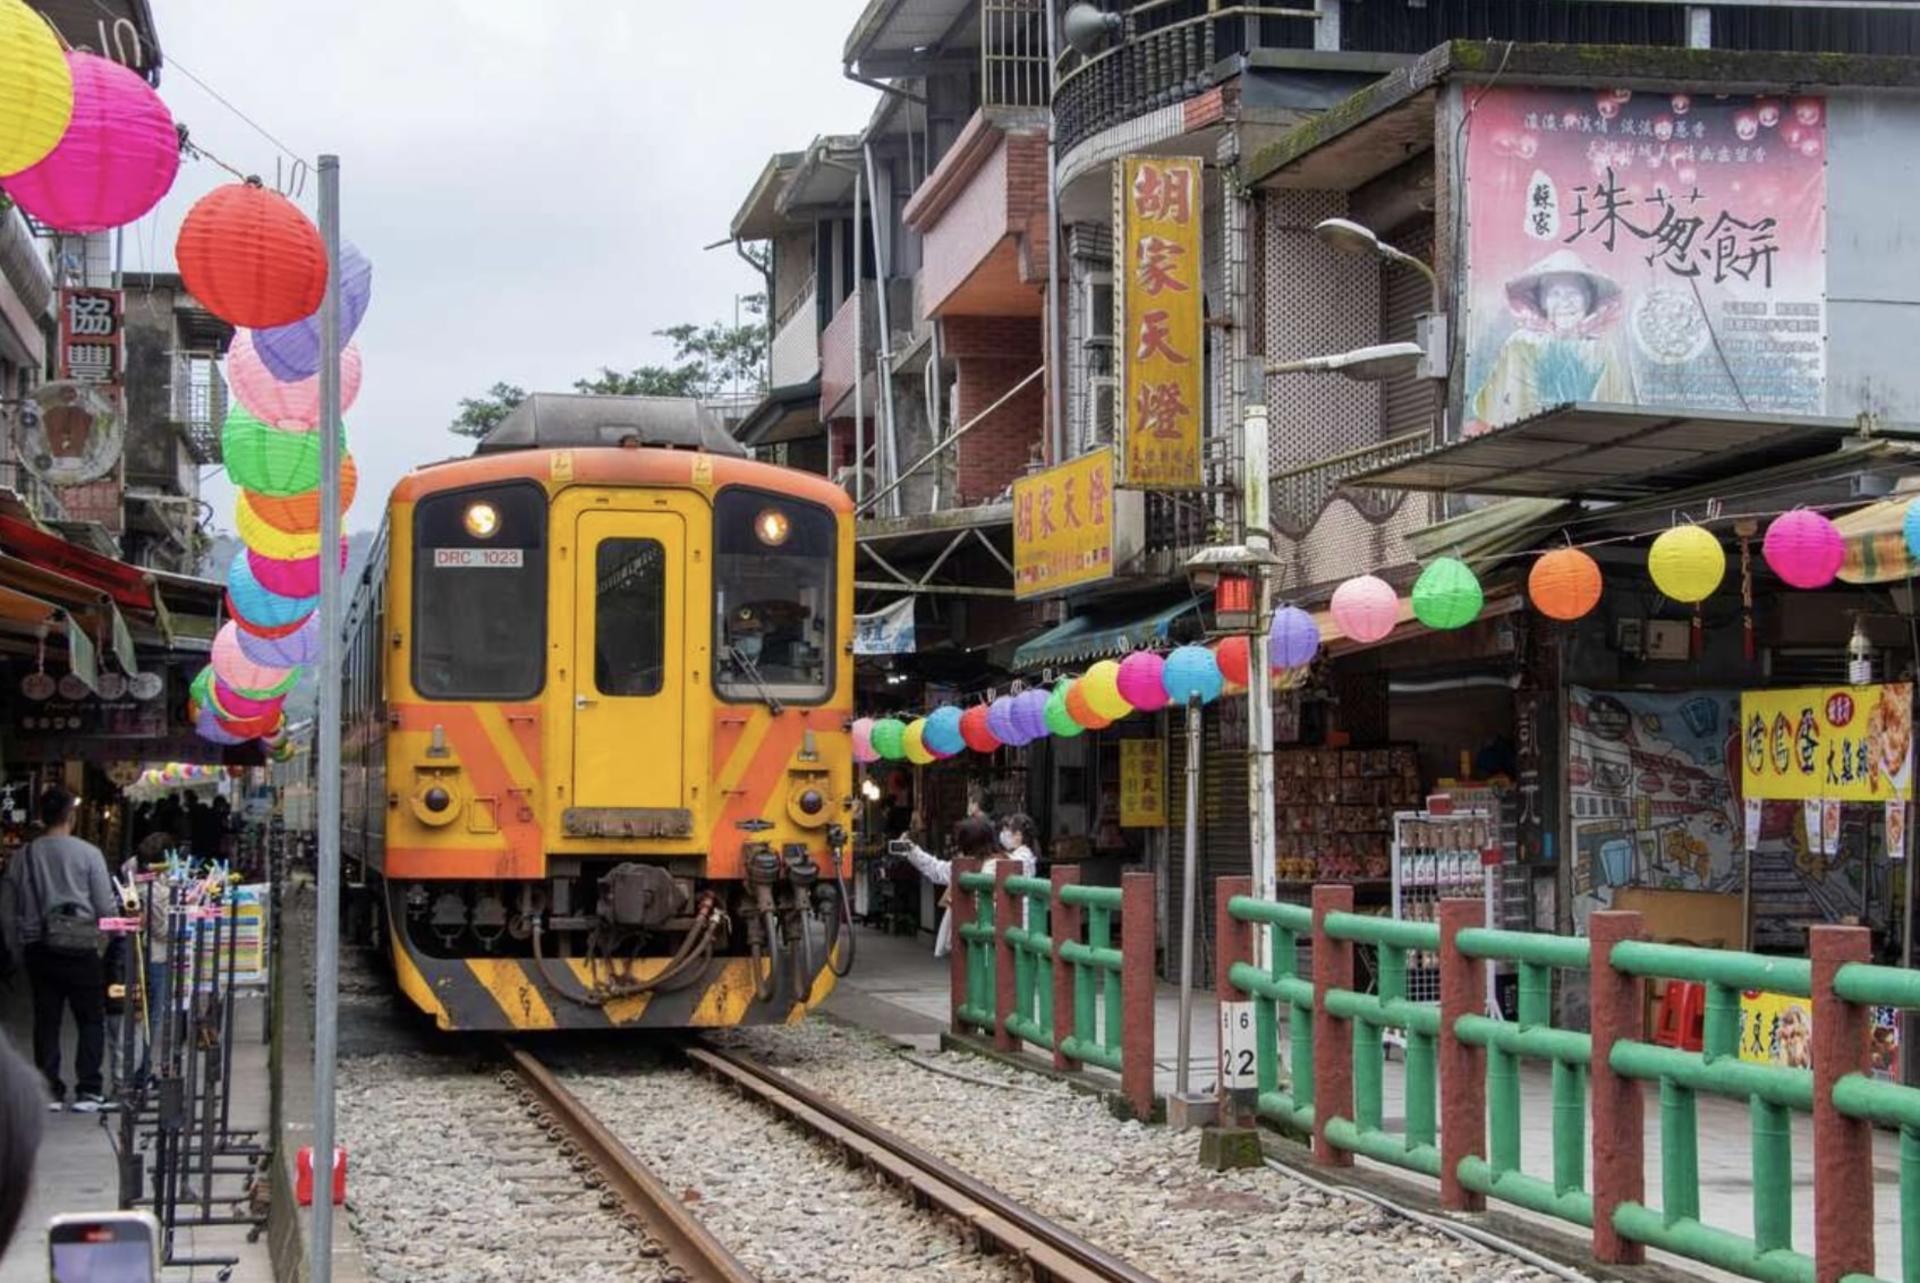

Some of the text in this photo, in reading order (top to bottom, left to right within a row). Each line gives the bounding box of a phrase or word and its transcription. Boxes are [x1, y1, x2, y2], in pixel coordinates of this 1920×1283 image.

[1133, 165, 1194, 439] 胡家天燈
[1017, 464, 1108, 544] 胡家天燈
[438, 551, 519, 564] DRC 1023
[1240, 1012, 1249, 1029] 6
